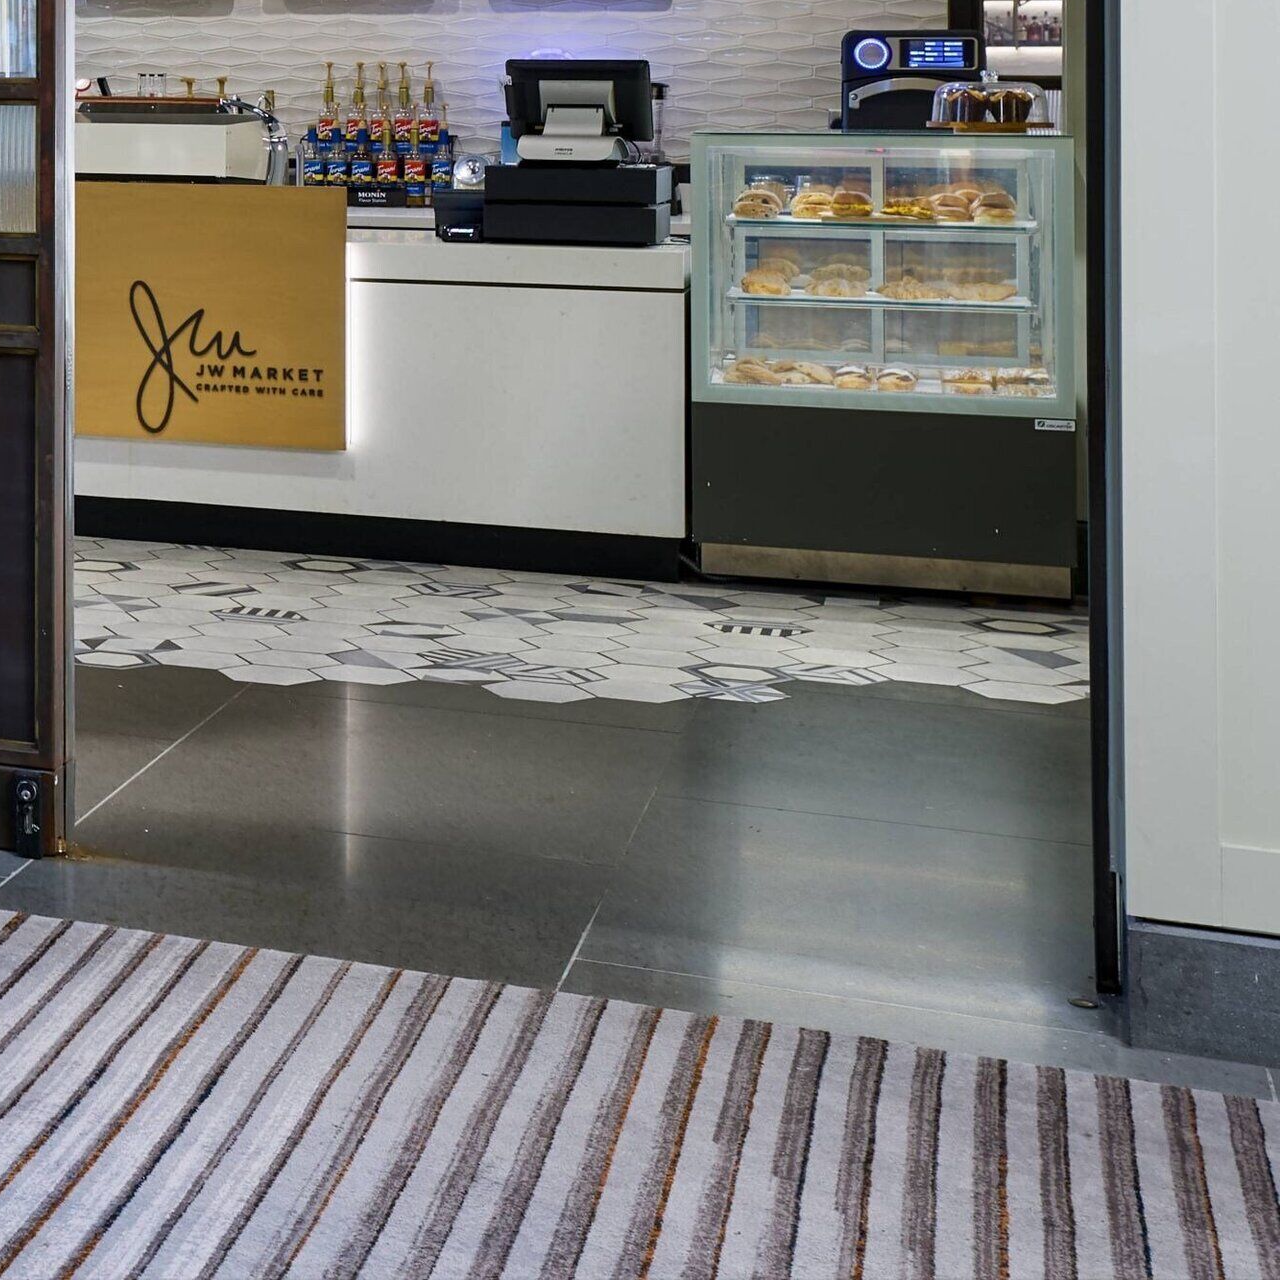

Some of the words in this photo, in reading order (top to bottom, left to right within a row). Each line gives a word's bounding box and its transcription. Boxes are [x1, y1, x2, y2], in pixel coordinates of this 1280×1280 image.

[358, 189, 386, 198] MONIN
[196, 364, 225, 378] JW
[232, 365, 325, 383] MARKET
[196, 383, 249, 394] CRAFTED
[255, 386, 286, 396] WITH
[292, 388, 325, 398] CARE
